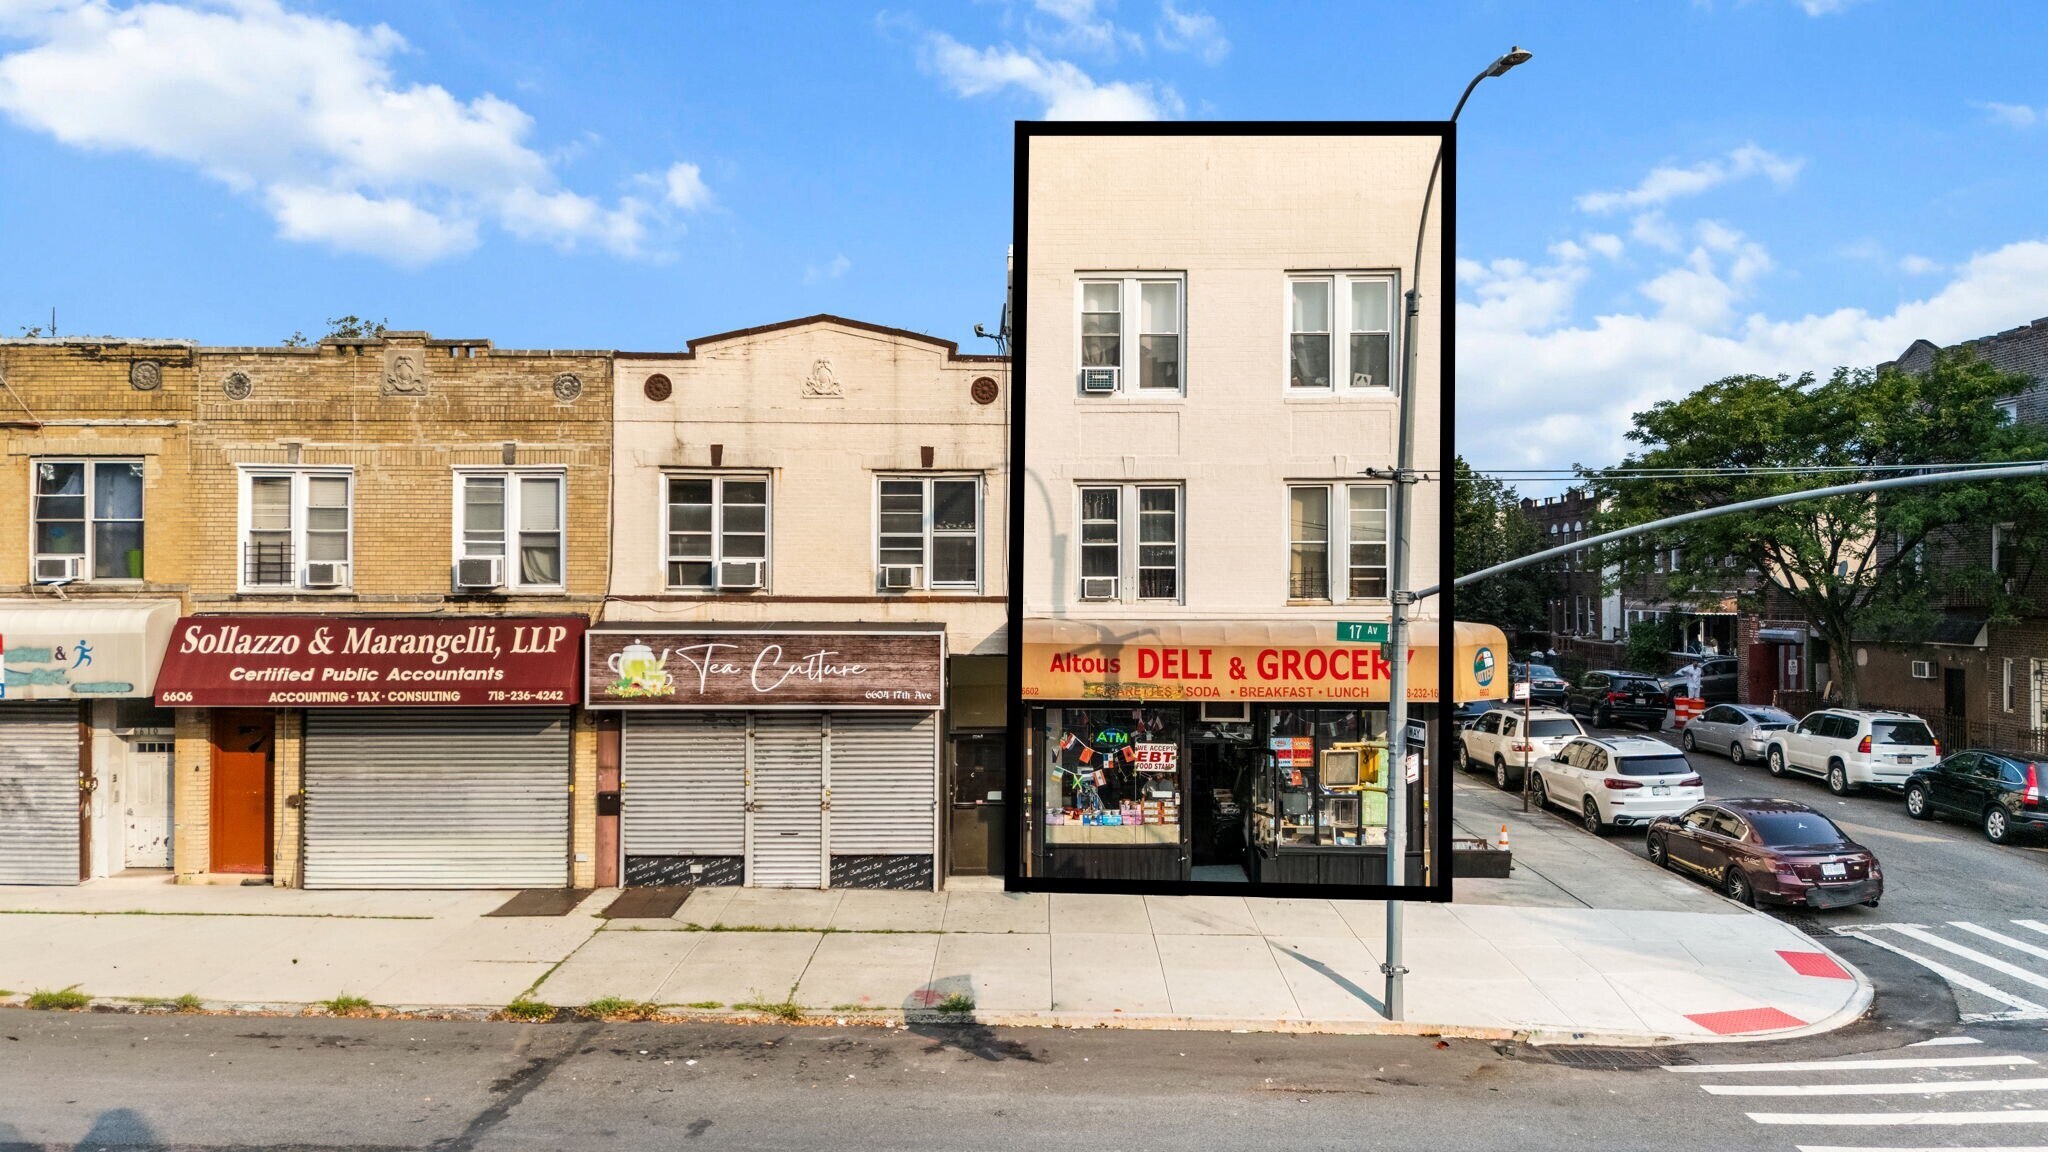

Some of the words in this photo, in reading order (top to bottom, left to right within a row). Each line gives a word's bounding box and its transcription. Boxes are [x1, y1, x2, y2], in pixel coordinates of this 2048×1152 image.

[1349, 624, 1362, 639] 17
[1367, 625, 1378, 635] Av
[180, 625, 301, 655] Sollazzo
[308, 626, 334, 655] &
[341, 625, 501, 664] Marangelli,
[510, 626, 567, 654] LLP
[54, 645, 67, 661] &
[675, 643, 741, 694] Tea
[751, 644, 867, 692] Culture
[1049, 652, 1121, 674] Altous
[1137, 648, 1213, 680] DELI
[1229, 656, 1247, 681] &
[229, 667, 315, 682] Certified
[322, 667, 379, 682] Public
[386, 667, 504, 681] Accountants
[163, 692, 193, 702] 6606
[268, 692, 348, 703] ACCOUNTING
[357, 691, 380, 702] TAX
[388, 691, 461, 702] CONSULTING
[488, 691, 563, 701] 718-236-4242
[865, 690, 889, 700] 6604
[893, 690, 911, 700] 17th
[914, 690, 932, 700] Ave
[1022, 687, 1039, 696] 6602
[1185, 686, 1221, 697] SODA
[1239, 687, 1313, 698] BREAKFAST
[1327, 687, 1369, 698] LUNCH
[1096, 731, 1128, 743] ATM
[1137, 751, 1174, 763] EBT
